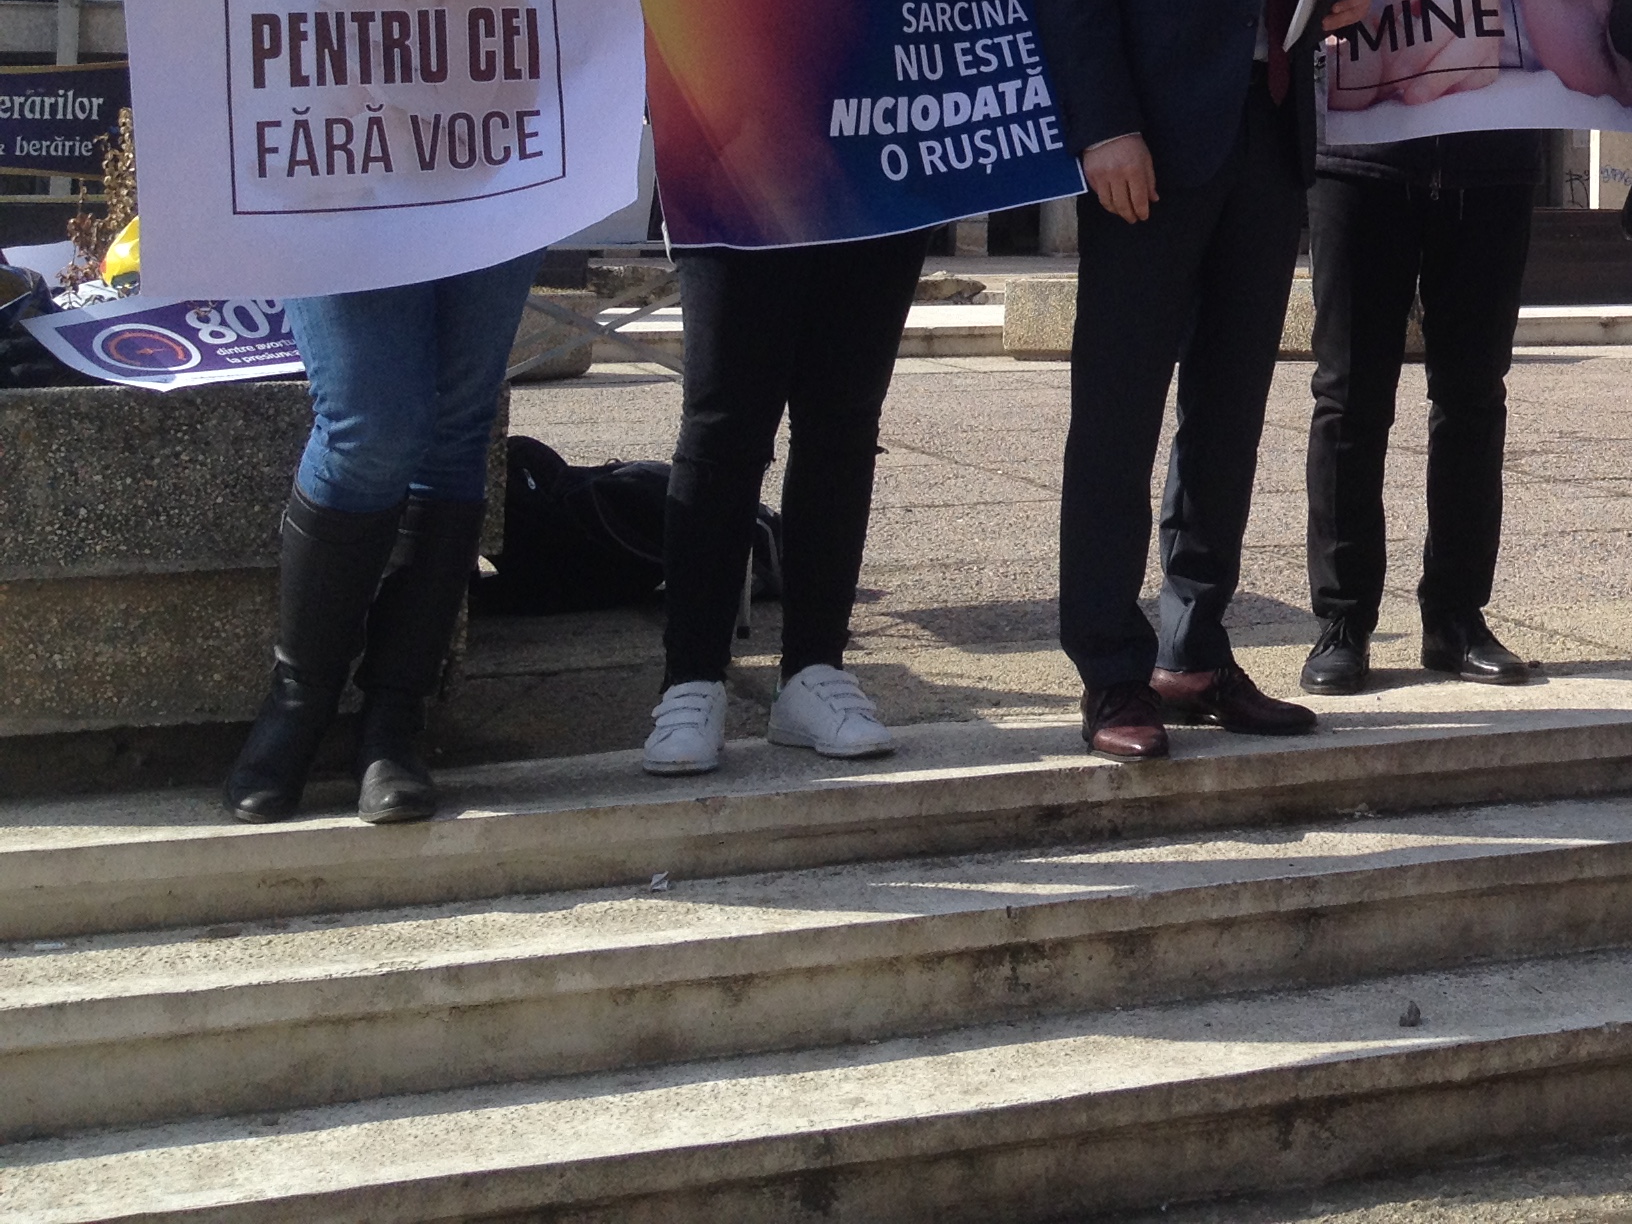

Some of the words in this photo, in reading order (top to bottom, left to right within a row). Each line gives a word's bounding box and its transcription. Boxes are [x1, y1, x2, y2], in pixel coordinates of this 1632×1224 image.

[251, 8, 448, 89] PENTRU
[467, 7, 541, 81] CEI
[893, 42, 943, 81] NU
[954, 31, 1039, 77] ESTE
[830, 65, 1052, 137] NICIODATĂ
[15, 136, 93, 156] berărie
[255, 103, 393, 178] FĂRĂ
[410, 109, 543, 171] VOCE
[880, 143, 908, 181] O
[919, 116, 1063, 175] RUȘINE
[216, 344, 255, 356] dintre
[256, 339, 297, 351] avortu
[226, 356, 242, 364] la
